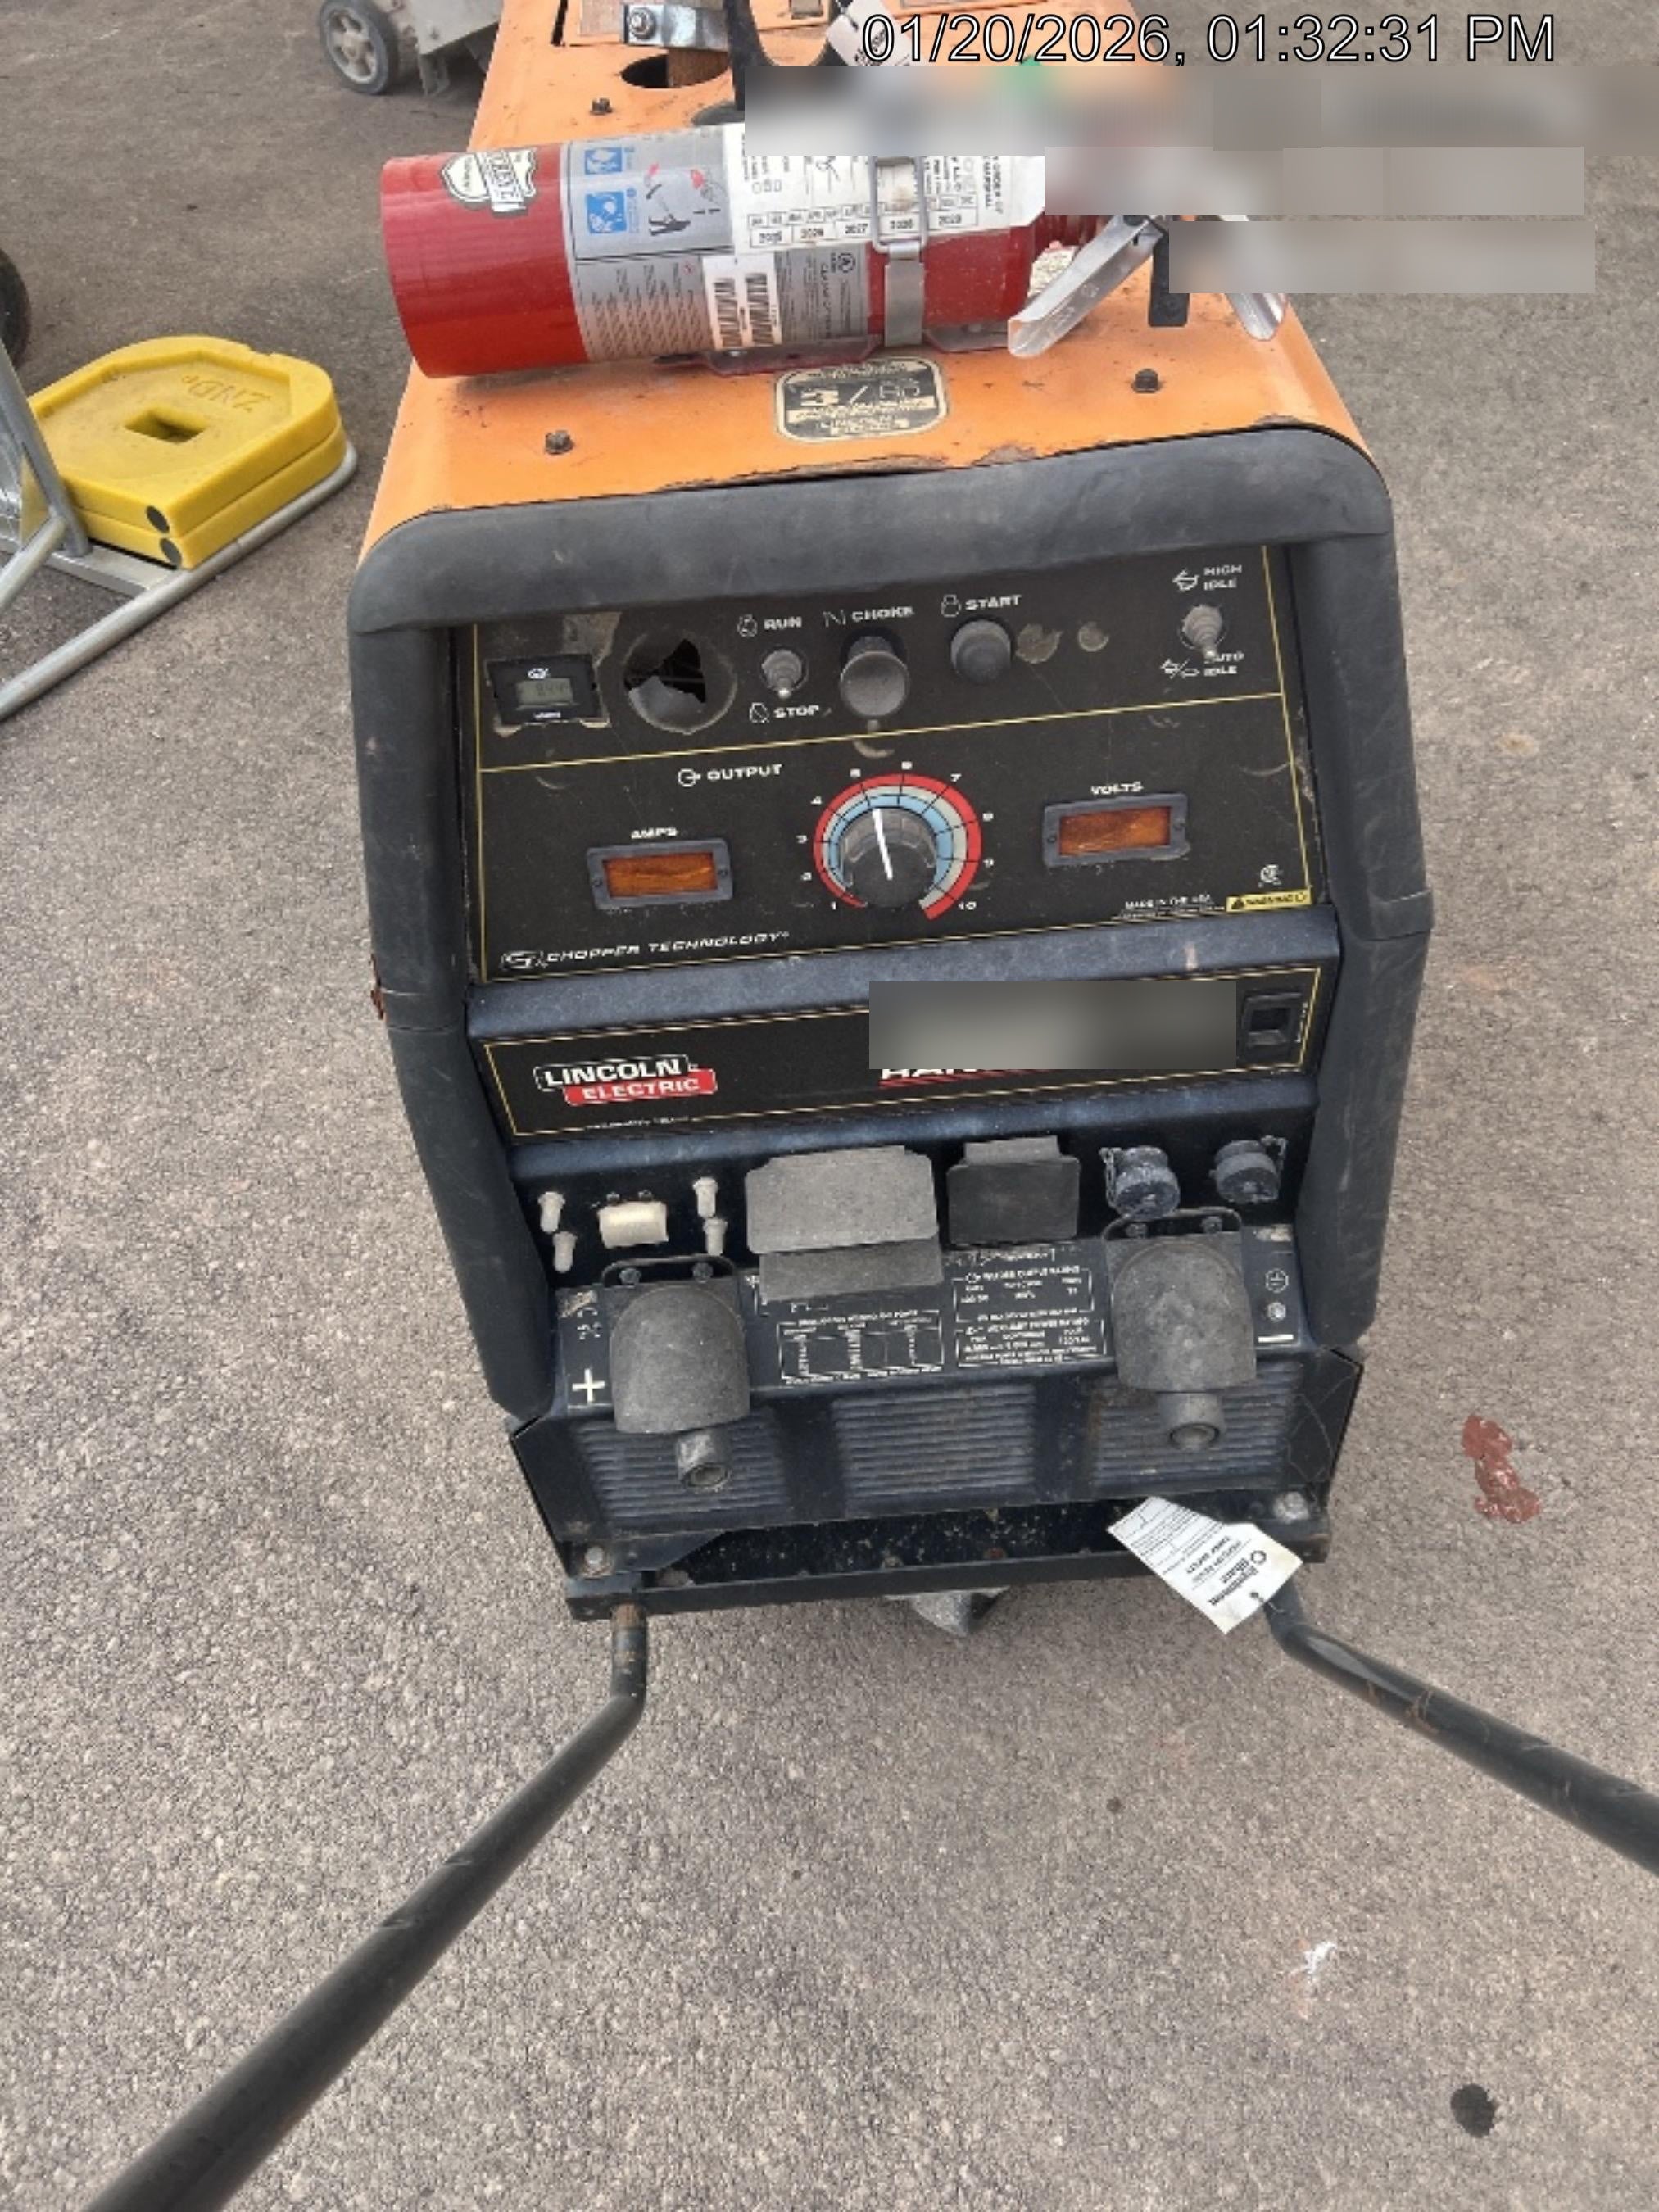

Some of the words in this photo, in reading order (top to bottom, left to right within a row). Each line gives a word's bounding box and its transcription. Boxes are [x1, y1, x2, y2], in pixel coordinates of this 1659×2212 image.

[1203, 564, 1242, 576] HIGH
[1203, 578, 1237, 591] IDLE
[965, 595, 1022, 610] START
[852, 605, 914, 622] CHOKE
[764, 616, 803, 630] RUN
[1203, 665, 1237, 677] IDLE
[773, 704, 820, 718] STOP
[707, 764, 783, 781] OUTPUT
[1090, 781, 1145, 796] VOLTS
[630, 827, 678, 840] AMPS
[958, 901, 977, 910] 10
[547, 945, 641, 963] CHOPPER
[544, 1058, 682, 1087] LINCOLN
[582, 1078, 700, 1100] ELECTRIC
